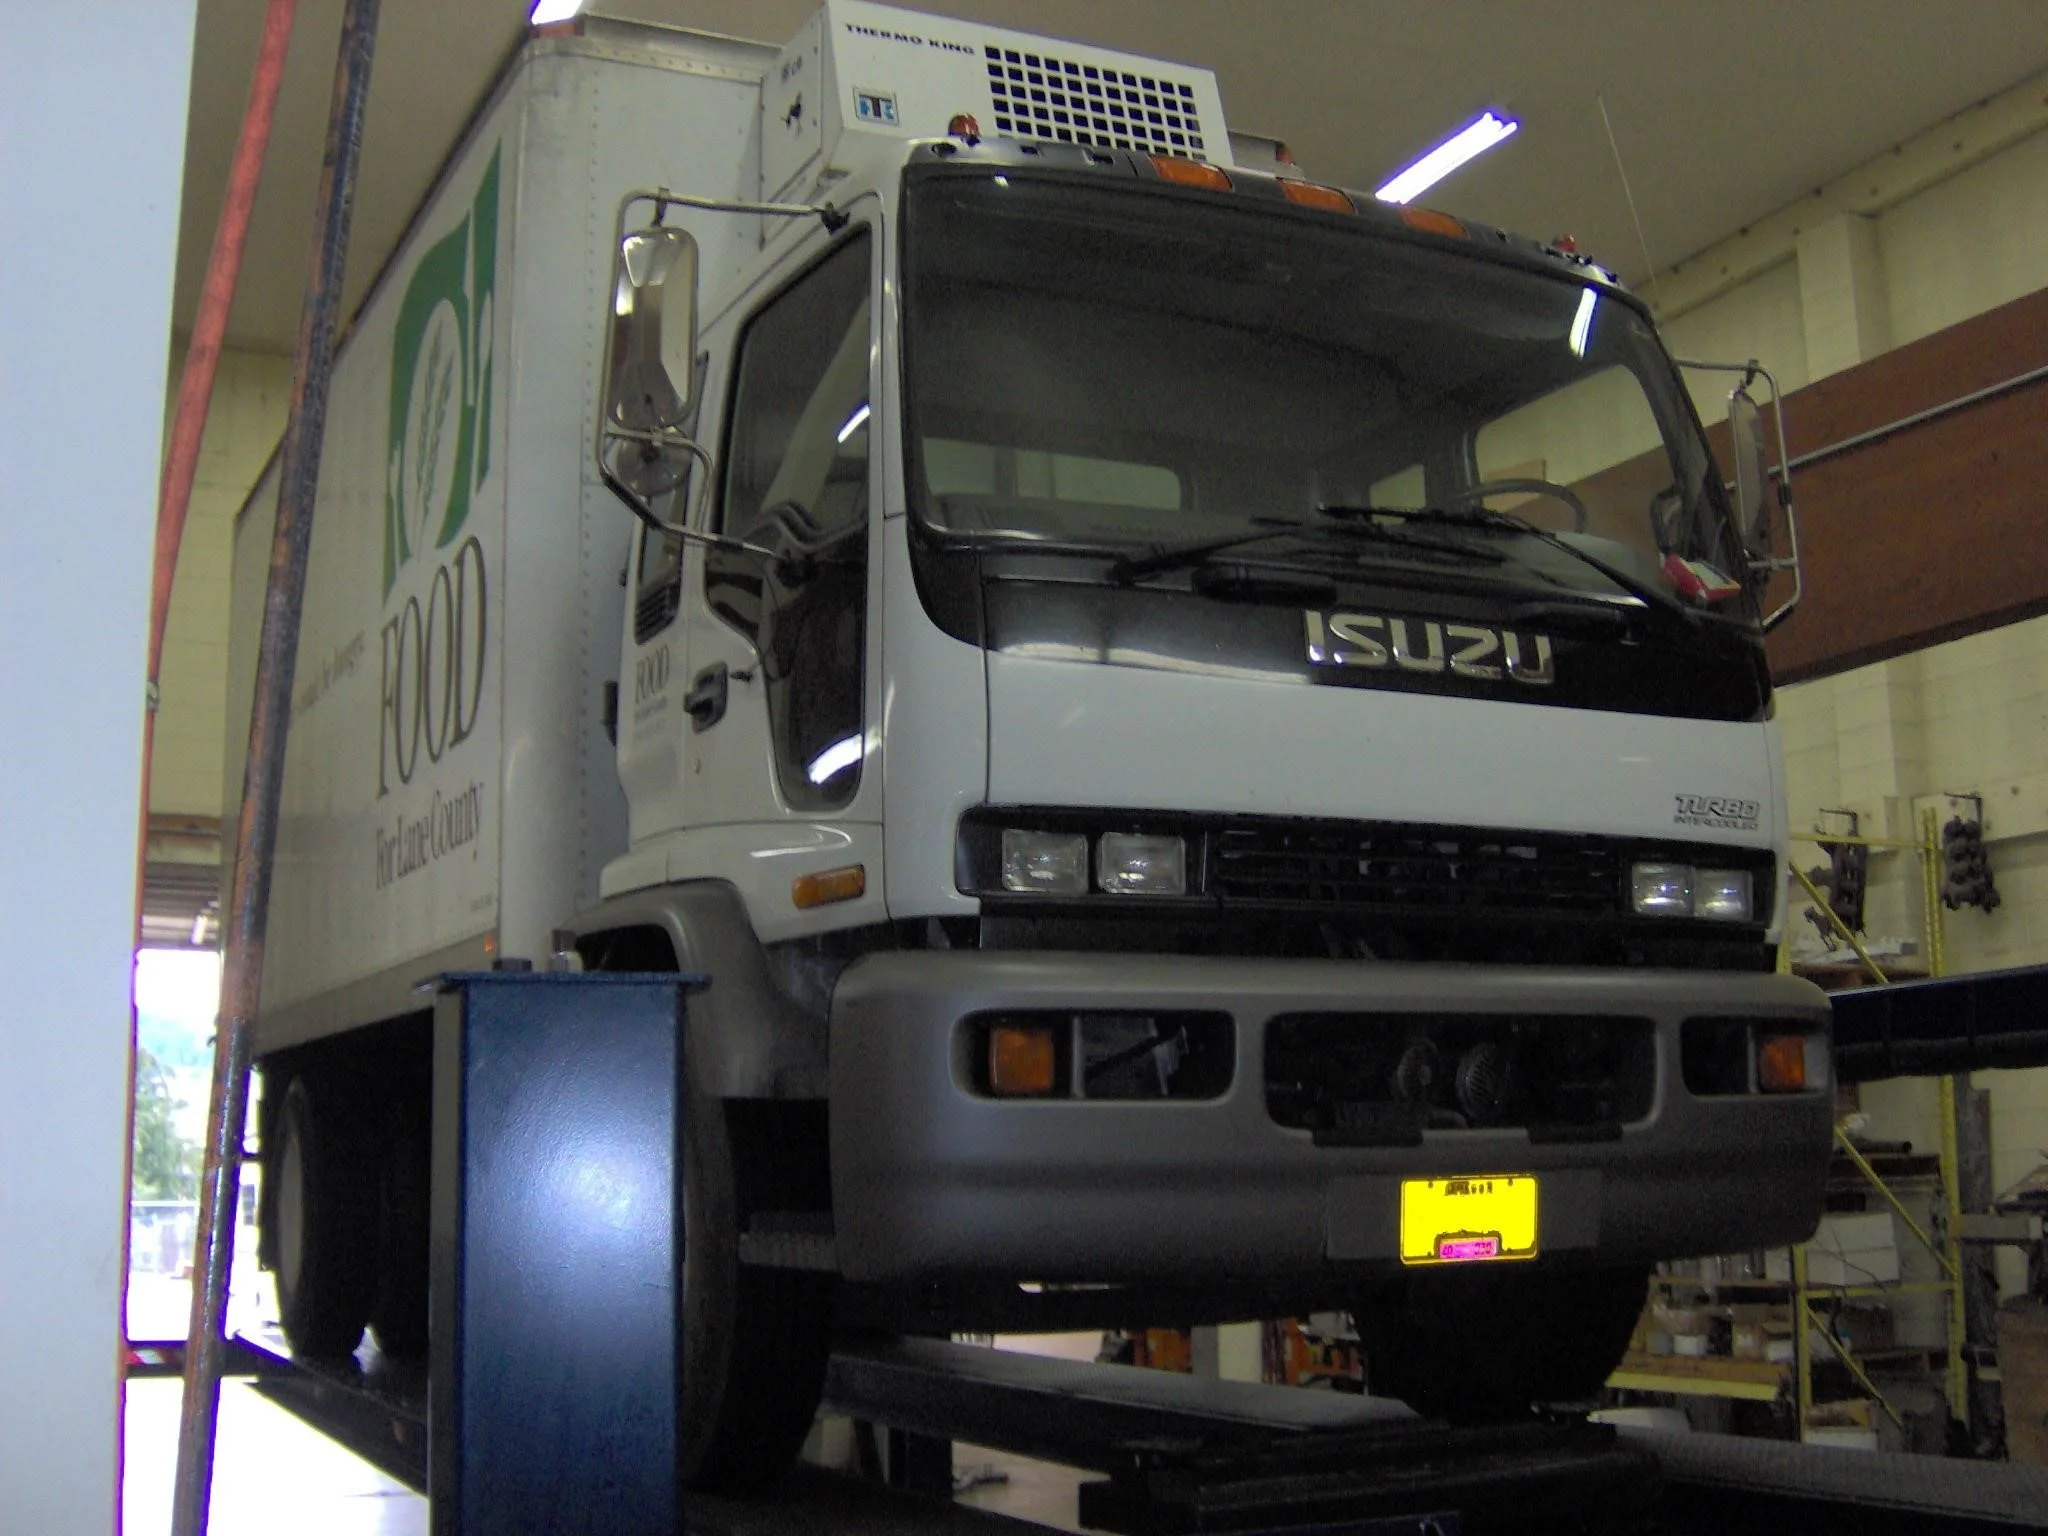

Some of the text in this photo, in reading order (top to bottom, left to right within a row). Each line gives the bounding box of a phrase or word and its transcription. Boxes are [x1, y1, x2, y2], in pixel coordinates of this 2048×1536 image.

[846, 23, 976, 56] THERMO KING
[377, 535, 486, 800] FOOD
[1305, 610, 1555, 684] ISUZU
[376, 780, 484, 890] For Lane County
[1674, 793, 1761, 820] TURBO
